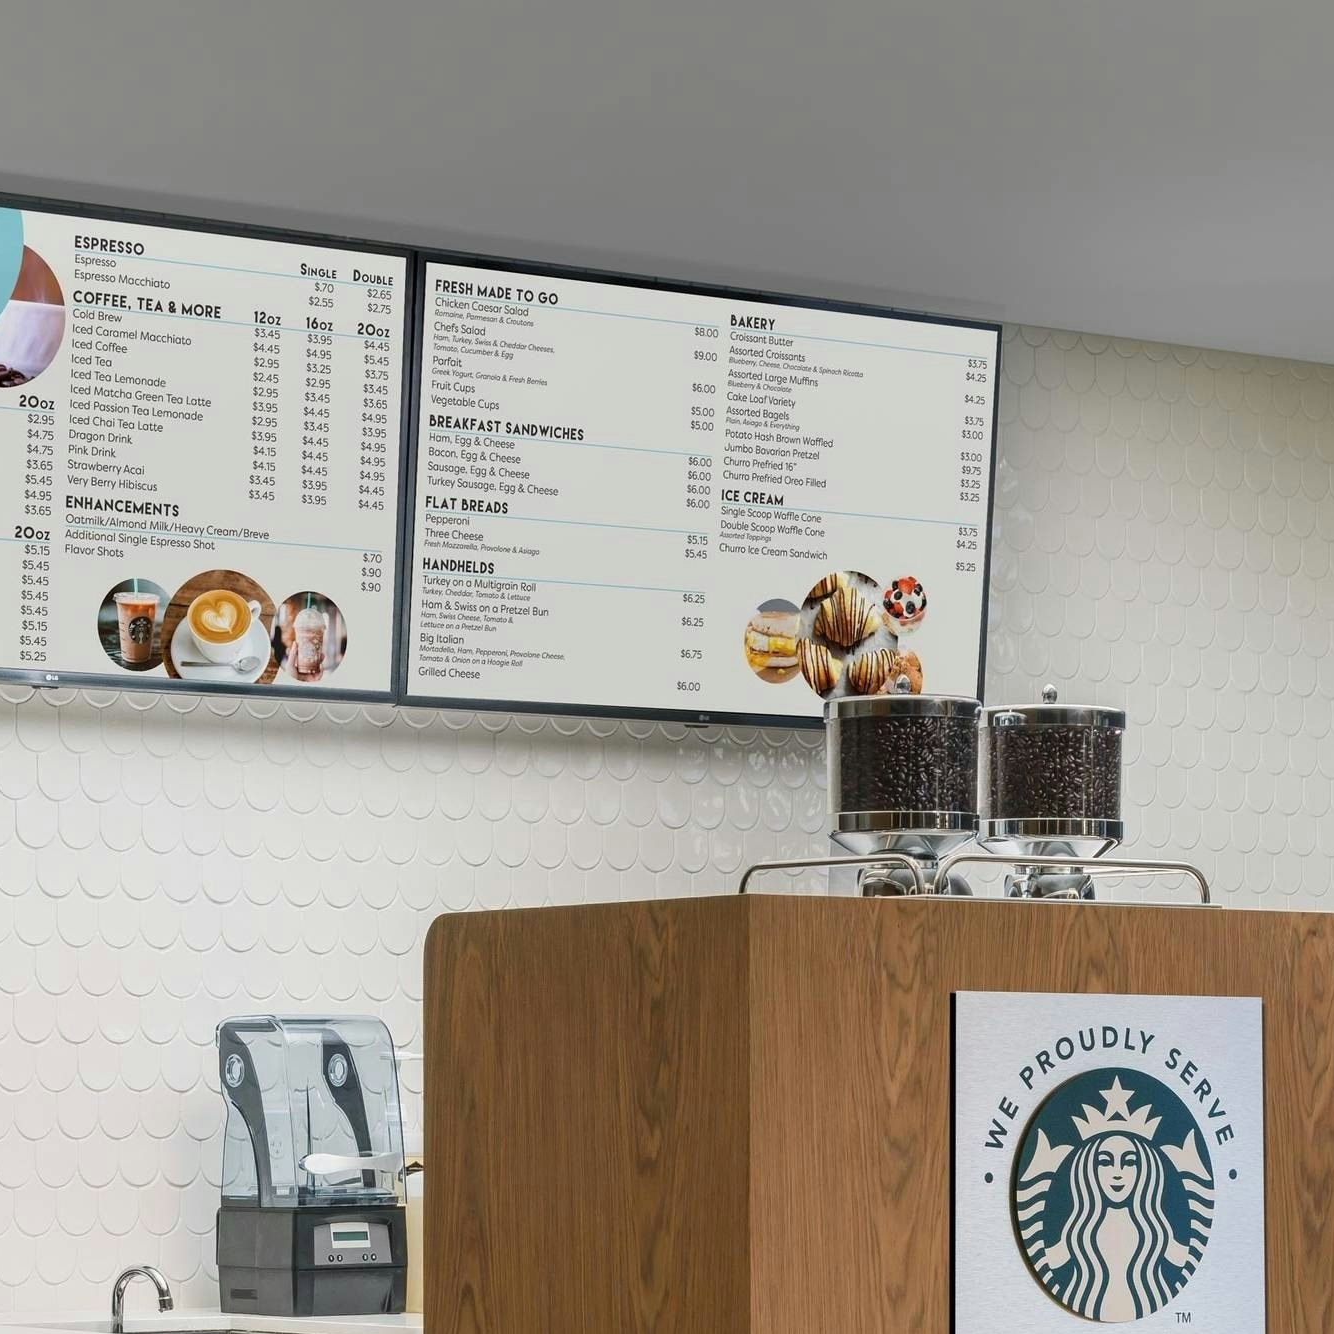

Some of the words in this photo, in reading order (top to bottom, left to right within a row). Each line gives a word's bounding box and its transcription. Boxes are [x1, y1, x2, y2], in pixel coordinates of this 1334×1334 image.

[74, 234, 145, 256] ESPRESSO
[74, 253, 116, 268] Espresso
[74, 268, 116, 283] Espresso
[118, 274, 171, 290] Macchiato
[314, 282, 334, 293] $.70
[367, 288, 392, 300] $2.65
[435, 278, 473, 296] FRESH
[476, 284, 512, 300] MADE
[516, 288, 534, 303] TO
[537, 291, 558, 305] GO
[72, 289, 131, 311] COFFEE,
[136, 296, 164, 312] TEA
[168, 300, 176, 314] &
[181, 302, 221, 319] MORE
[435, 296, 470, 310] Chicken
[471, 301, 502, 313] Caesar
[504, 304, 529, 317] Salad
[72, 308, 95, 320] Cold
[97, 310, 122, 322] Brew
[253, 310, 281, 326] 12oz
[466, 312, 498, 322] Parmesan
[498, 316, 505, 324] &
[505, 317, 534, 327] Croutons
[730, 313, 775, 331] BAKERY
[306, 316, 333, 332] 16oz
[357, 322, 390, 338] 20oz
[433, 321, 459, 333] Chefs
[460, 324, 486, 336] Salad
[694, 326, 719, 338] $8.00
[72, 323, 93, 335] Iced
[95, 325, 137, 339] Caramel
[140, 331, 192, 346] Macchiato
[254, 327, 281, 340] $3.45
[307, 333, 332, 345] $3.95
[729, 330, 767, 344] Croissant
[768, 335, 794, 347] Butter
[363, 339, 390, 352] $4.45
[432, 355, 462, 367] Parfait
[967, 358, 987, 370] $3.75
[431, 379, 451, 391] Fruit
[453, 381, 475, 394] Cups
[18, 394, 55, 410] 20oz
[430, 394, 476, 408] Vegetable
[477, 398, 499, 411] Cups
[27, 413, 55, 426] $2.95
[429, 414, 502, 433] BREAKFAST
[505, 421, 584, 441] SANDWICHES
[68, 428, 105, 443] Dragon
[107, 432, 133, 444] Drink
[428, 432, 452, 444] Ham,
[454, 434, 472, 448] Egg
[473, 436, 481, 446] &
[483, 437, 515, 449] Cheese
[724, 442, 753, 454] Jumbo
[755, 445, 790, 457] Bavarian
[792, 448, 820, 460] Pretzel
[67, 458, 122, 475] Strawberry
[122, 464, 145, 475] Acai
[25, 473, 53, 486] $5.45
[67, 474, 88, 487] Very
[90, 476, 117, 490] Berry
[118, 479, 157, 492] Hibiscus
[425, 495, 457, 510] FLAT
[461, 498, 508, 514] BREADS
[721, 488, 740, 502] ICE
[743, 491, 784, 506] CREAM
[65, 495, 179, 517] ENHANCEMENTS
[425, 513, 470, 526] Pepperoni
[14, 525, 50, 541] 20oz
[425, 527, 450, 539] Three
[451, 529, 484, 542] Cheese
[719, 531, 745, 539] Assorted
[746, 533, 771, 543] Toppings
[24, 543, 50, 556] $5.15
[362, 552, 382, 564] $.70
[422, 557, 495, 574] HANDHELDS
[955, 561, 976, 572] $5.25
[422, 574, 451, 588] Turkey
[452, 579, 464, 587] on
[474, 579, 518, 592] Multigrain
[520, 582, 536, 592] Roll
[419, 632, 434, 645] Big
[436, 634, 464, 644] Italian
[418, 666, 446, 677] Grilled
[448, 668, 481, 679] Cheese
[676, 681, 700, 691] $6.00
[984, 1096, 1021, 1151] WE
[1018, 1025, 1155, 1091] PROUDLY
[1164, 1047, 1236, 1147] SERVE
[1175, 1312, 1192, 1324] TM
